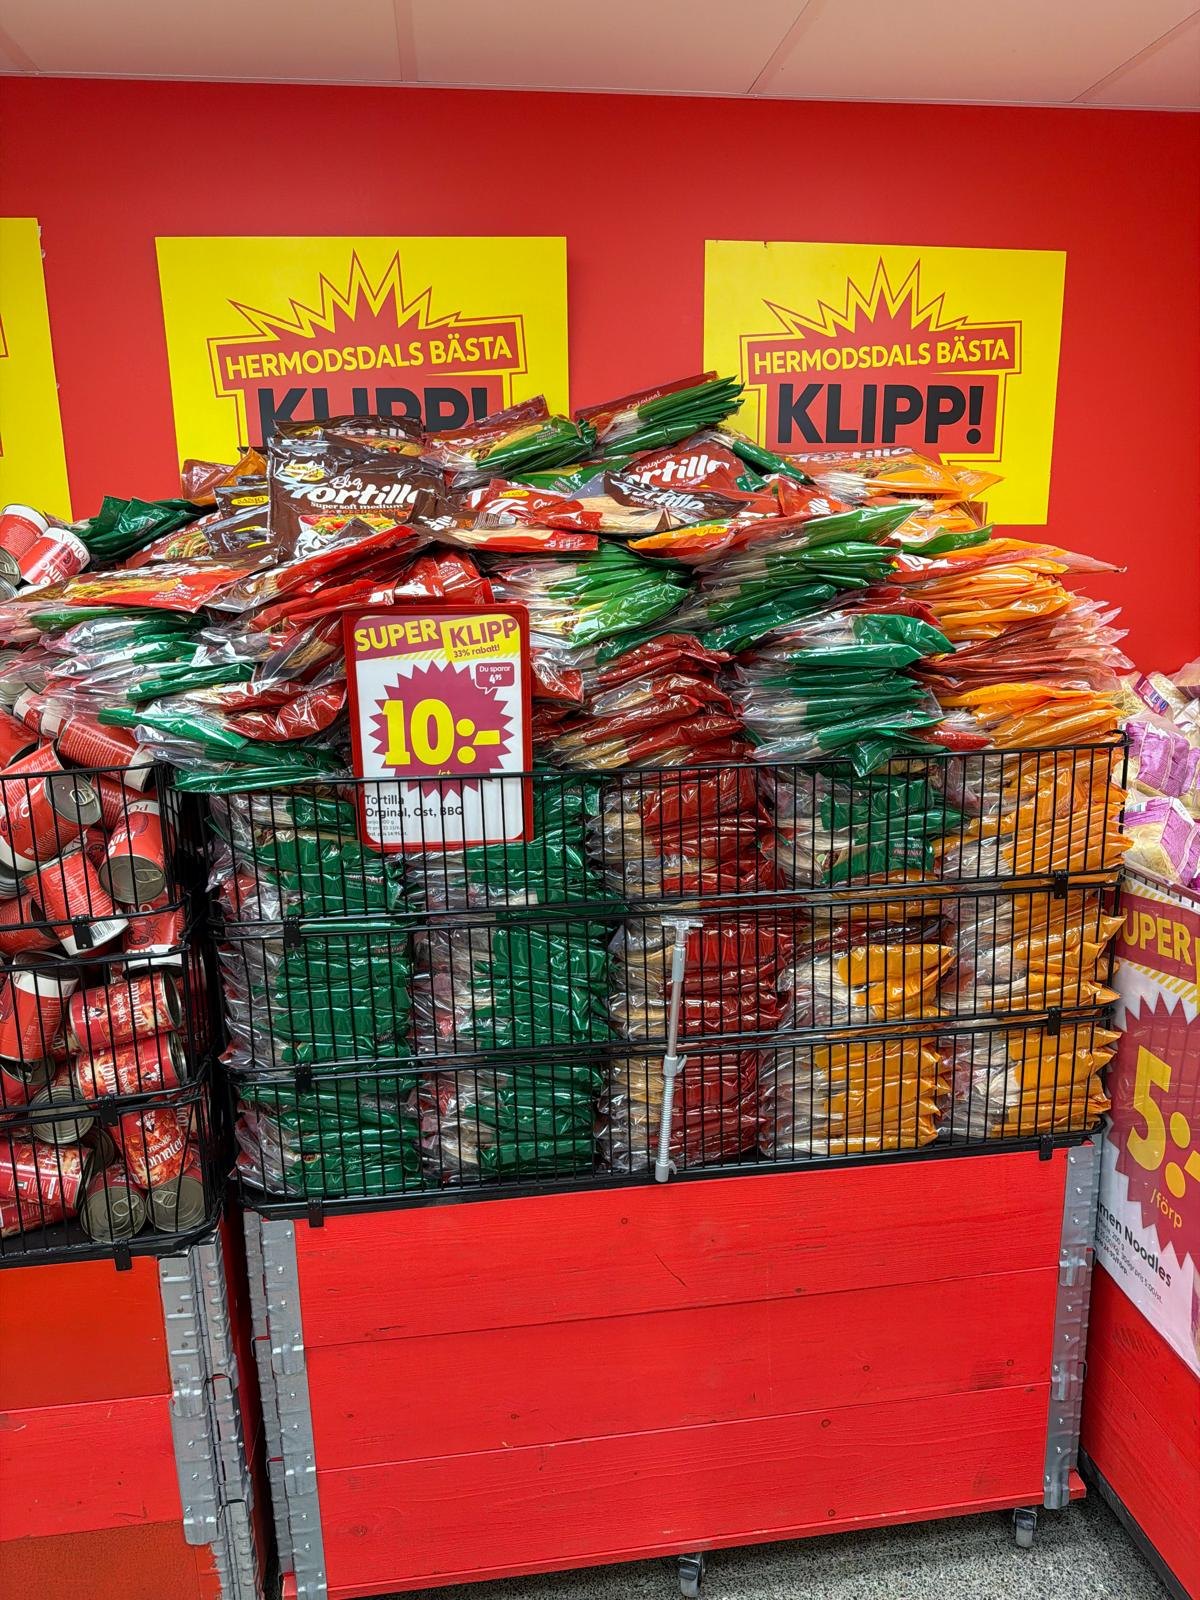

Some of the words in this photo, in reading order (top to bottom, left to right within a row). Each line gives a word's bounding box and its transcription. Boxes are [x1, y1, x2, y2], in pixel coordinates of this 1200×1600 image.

[226, 345, 424, 380] HERMODSDALS
[430, 333, 513, 365] BÄSTA
[754, 342, 931, 375] HERMODSDALS
[936, 335, 1010, 364] BÄSTA
[777, 383, 985, 445] KLIPP!
[354, 618, 439, 652] SUPER
[449, 618, 518, 649] KLIPP
[453, 649, 471, 658] 33%
[472, 644, 501, 655] rabatt!
[489, 665, 511, 674] sparar
[382, 698, 501, 766] 10:-
[364, 794, 405, 805] Tortilla
[365, 807, 411, 819] Orginal,
[413, 807, 437, 818] Ost,
[440, 806, 464, 816] BBQ
[1121, 907, 1193, 967] UPER
[1150, 1188, 1183, 1229] /förp
[1124, 1225, 1172, 1288] Noodles
